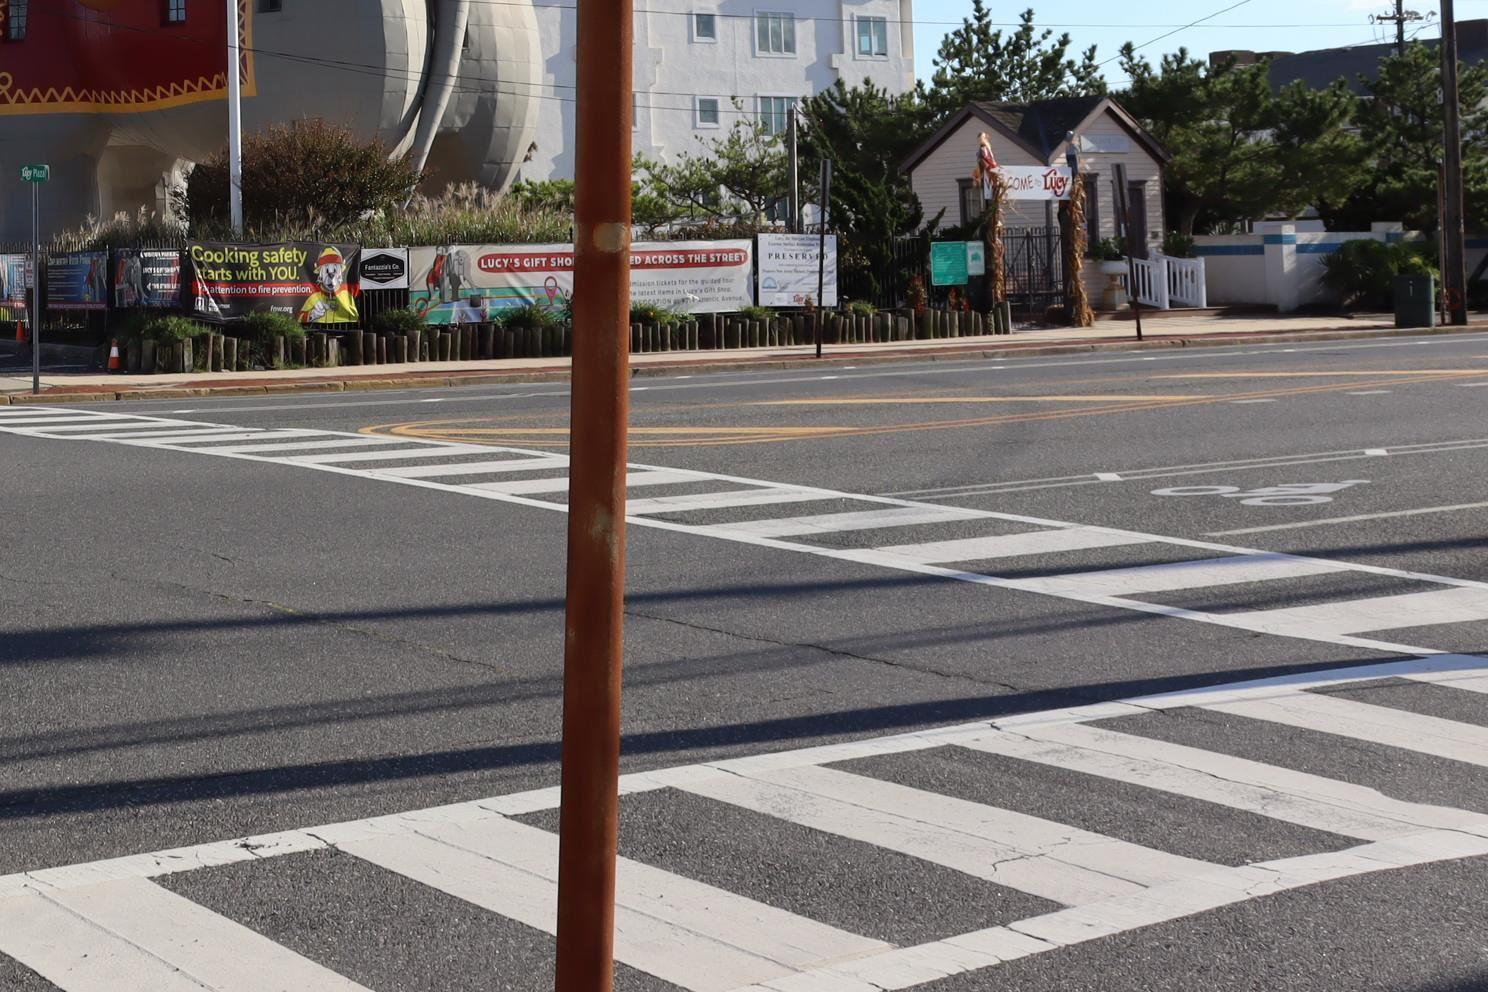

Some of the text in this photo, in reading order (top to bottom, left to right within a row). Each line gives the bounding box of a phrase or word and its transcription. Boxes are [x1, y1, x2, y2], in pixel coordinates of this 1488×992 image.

[1041, 168, 1069, 197] Lucy
[191, 245, 260, 267] Cooking
[263, 247, 308, 267] safety
[481, 258, 520, 268] LUCY'S
[523, 257, 547, 268] GIFT
[550, 256, 575, 267] SHO
[644, 254, 686, 265] ACROSS
[688, 254, 707, 263] THE
[709, 252, 746, 262] STREET
[197, 267, 300, 281] tarts with YOU.
[210, 285, 247, 294] attention
[248, 286, 257, 294] to
[258, 285, 271, 294] fire
[272, 285, 313, 296] prevention.
